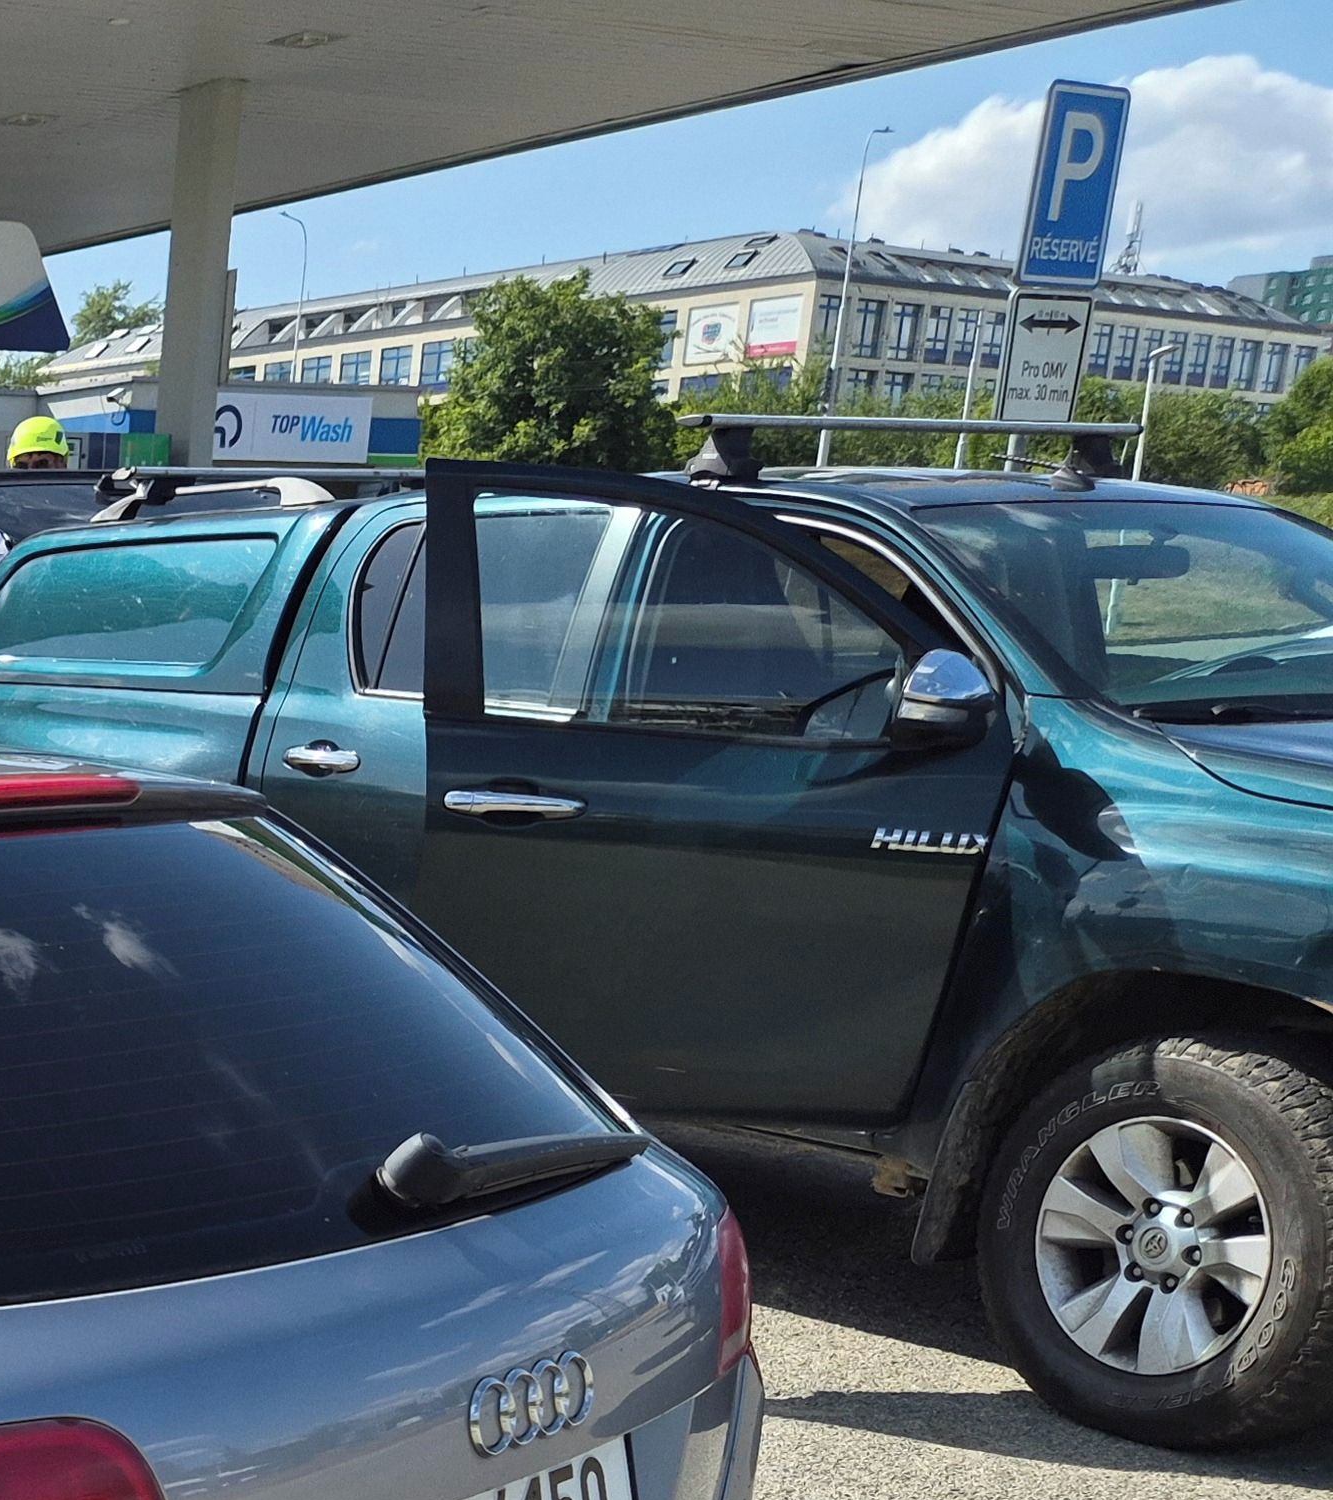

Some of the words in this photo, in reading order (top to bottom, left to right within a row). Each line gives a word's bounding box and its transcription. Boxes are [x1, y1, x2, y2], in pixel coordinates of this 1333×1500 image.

[1046, 111, 1106, 222] P
[1029, 229, 1100, 264] RÉSERVÉ
[1021, 360, 1040, 378] Pro
[1042, 361, 1068, 379] OMV
[1007, 387, 1032, 401] max.
[1034, 383, 1047, 401] 30
[1048, 385, 1071, 403] min.
[870, 827, 990, 855] HILUX
[996, 1080, 1161, 1230] WRANGLER
